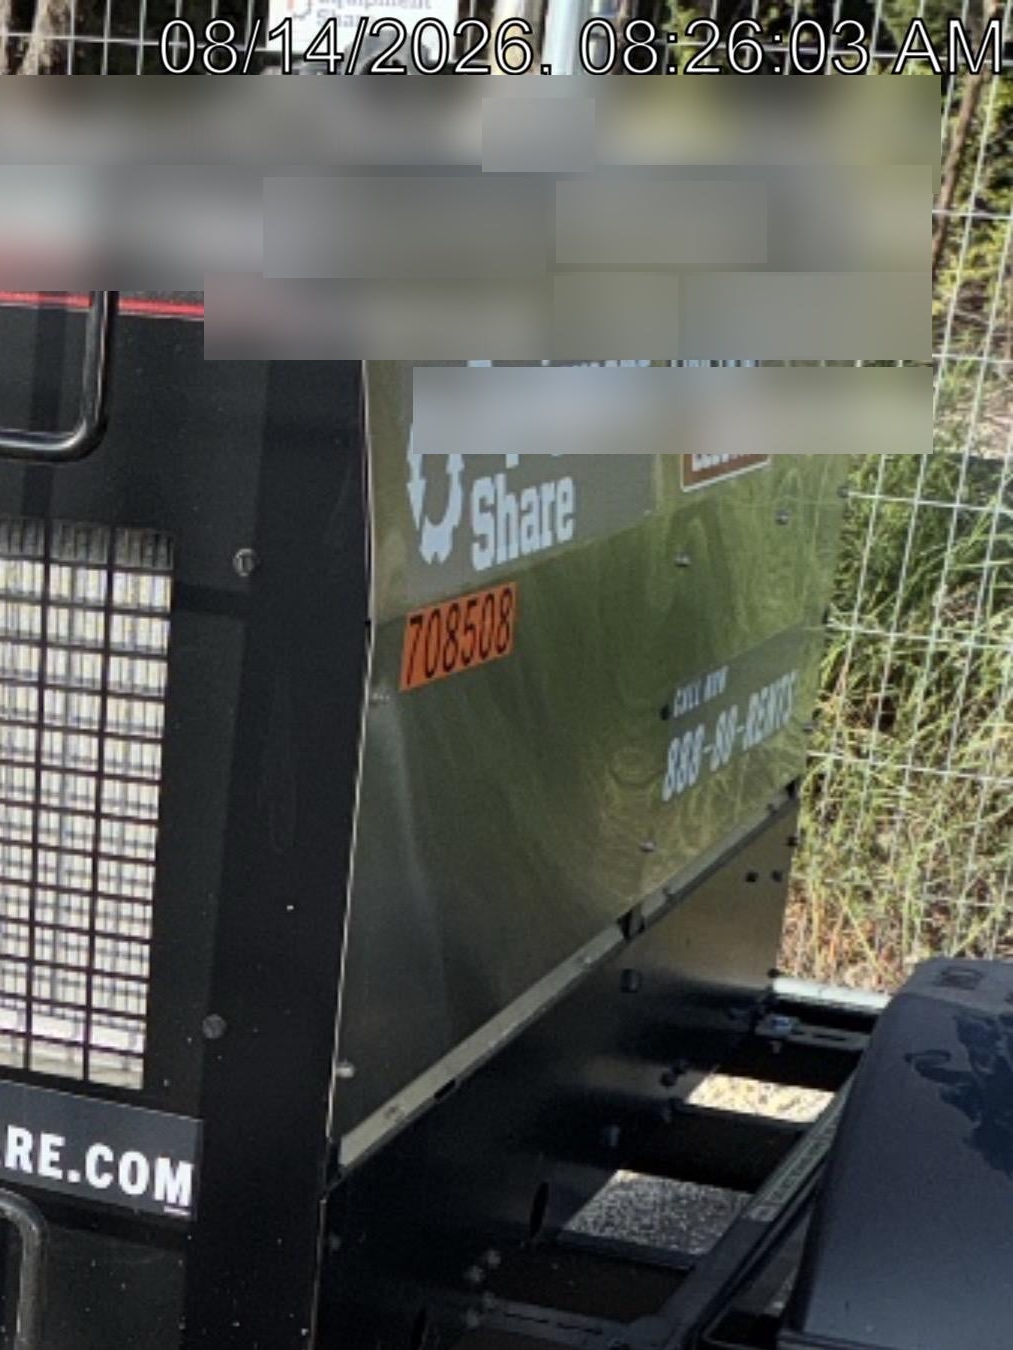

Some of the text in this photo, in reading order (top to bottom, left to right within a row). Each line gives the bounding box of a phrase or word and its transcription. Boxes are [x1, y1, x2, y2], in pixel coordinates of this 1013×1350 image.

[471, 473, 575, 571] Share
[406, 586, 513, 686] 708508
[674, 678, 702, 718] CALL
